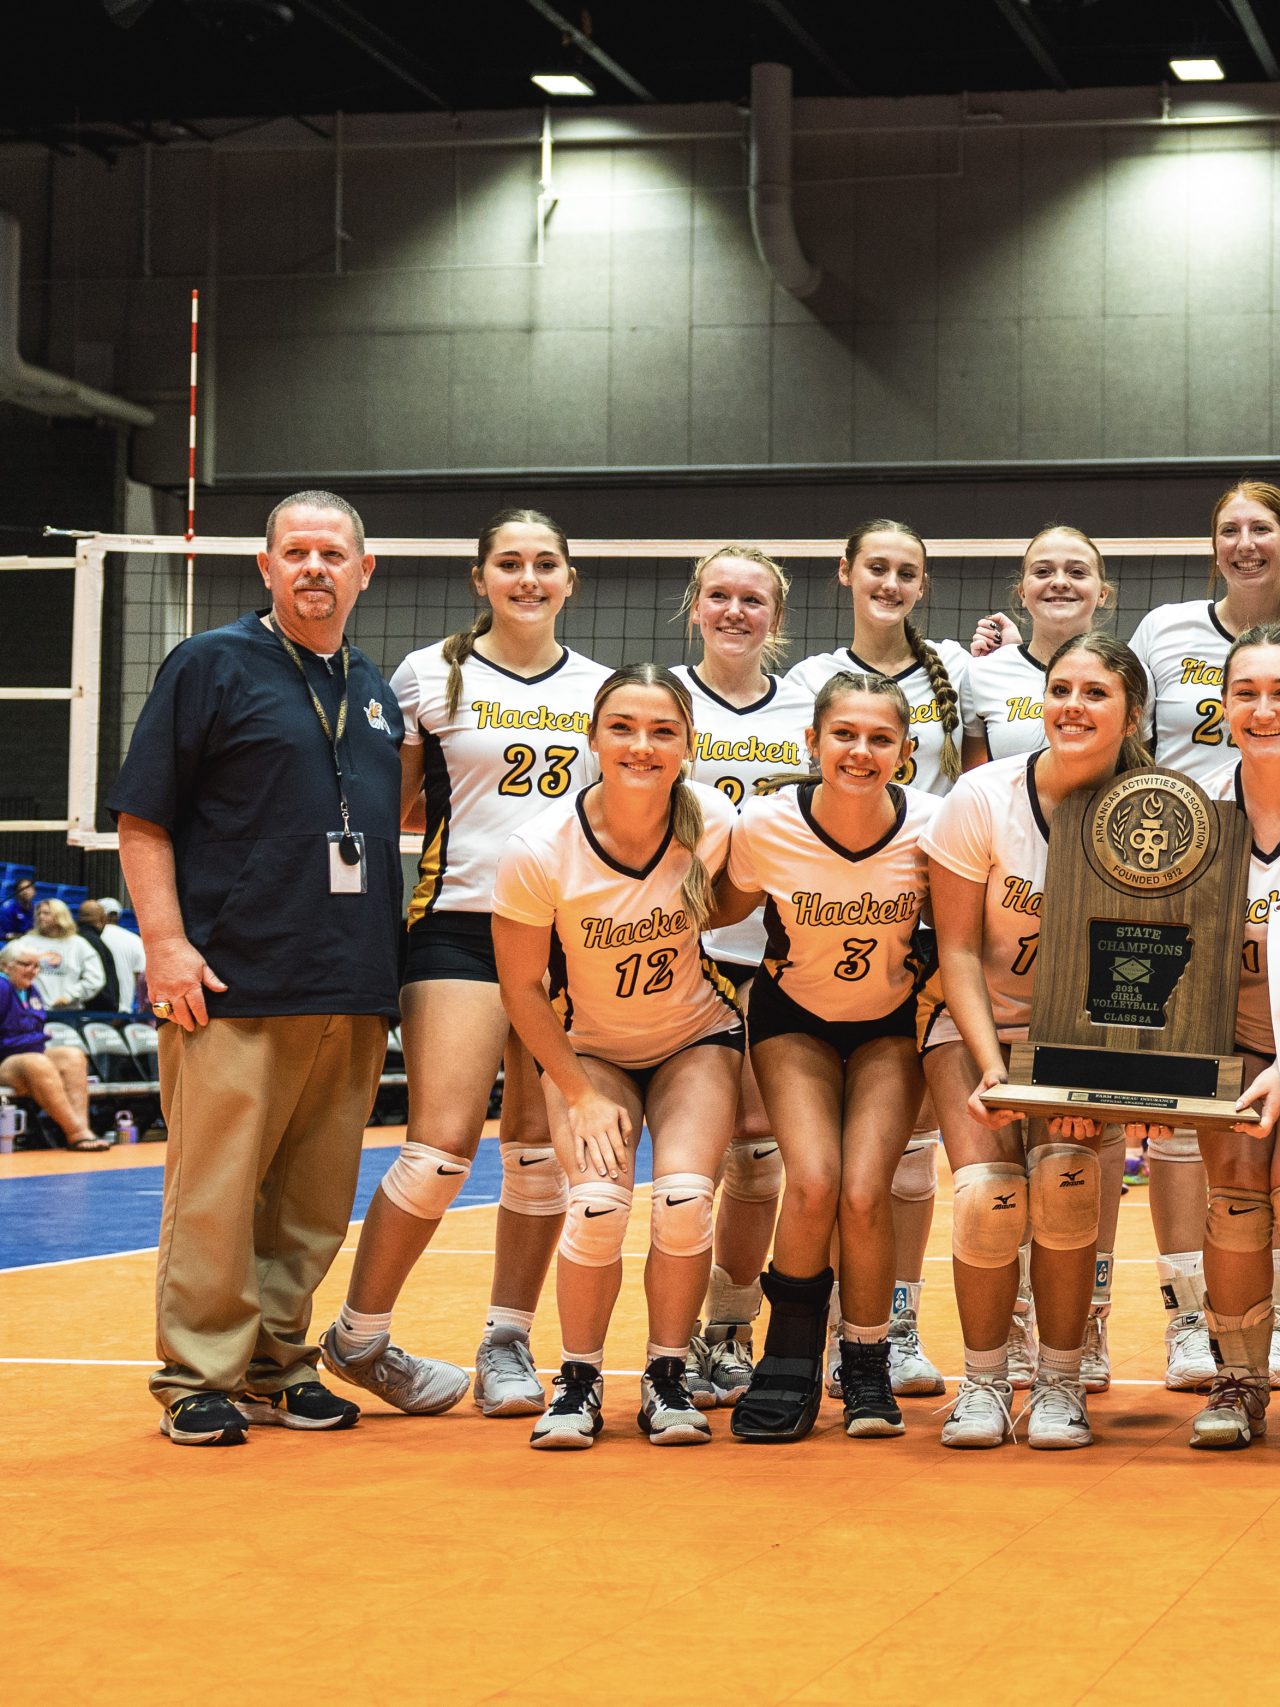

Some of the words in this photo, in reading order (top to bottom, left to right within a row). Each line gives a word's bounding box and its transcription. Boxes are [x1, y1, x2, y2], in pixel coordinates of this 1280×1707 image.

[471, 700, 591, 735] Hackett
[693, 732, 801, 765] Hackett
[498, 743, 579, 798] 23
[1095, 790, 1121, 843] ARKANSAS
[1121, 777, 1177, 793] ACTIVITIES
[1177, 787, 1207, 849] ASSOCIATION
[1112, 864, 1160, 884] FOUNDED
[1162, 867, 1184, 882] 1912
[792, 891, 917, 926] Hackett
[581, 907, 690, 949] Hacke
[1116, 926, 1162, 940] STATE
[834, 937, 878, 981] 3
[1097, 940, 1183, 956] CHAMPIONS
[615, 947, 678, 998] 12
[1115, 984, 1140, 993] 2024
[1092, 998, 1160, 1011] VOLLEYBALL
[1111, 992, 1143, 1001] GIRLS
[1104, 1012, 1137, 1023] CLASS
[1139, 1015, 1152, 1024] 2A
